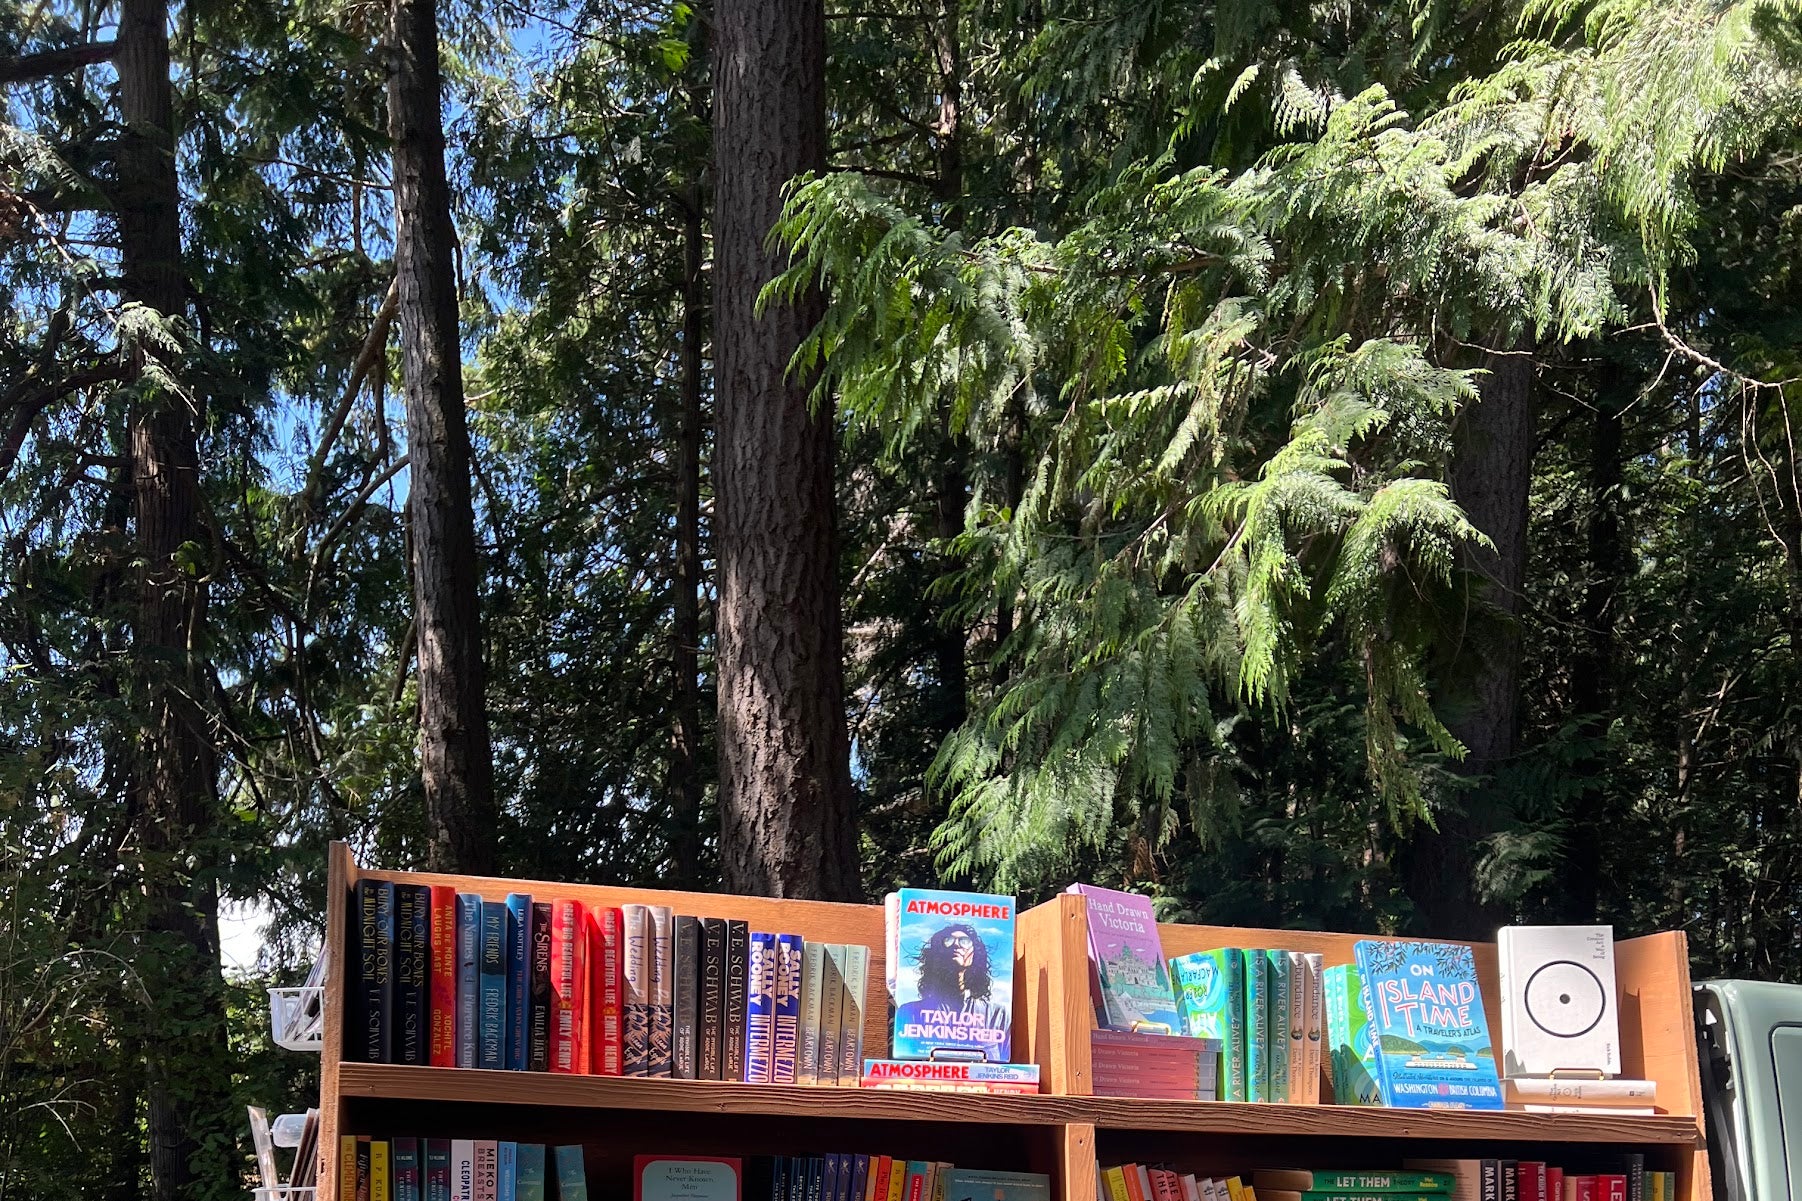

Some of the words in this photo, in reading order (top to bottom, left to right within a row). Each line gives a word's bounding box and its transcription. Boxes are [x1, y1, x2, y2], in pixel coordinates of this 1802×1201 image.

[464, 901, 477, 922] The
[486, 916, 499, 929] MY
[906, 899, 1011, 921] ATMOSPHERE
[1088, 897, 1115, 916] Hand
[1117, 903, 1150, 920] Drawn
[1099, 912, 1146, 934] Victoria
[733, 923, 744, 935] V.
[463, 924, 477, 964] Names
[486, 932, 499, 965] FRIENDS
[732, 938, 744, 951] E.
[751, 942, 763, 1007] ROONEY
[1277, 956, 1286, 967] IS
[1410, 964, 1435, 977] ON
[730, 954, 743, 1023] SCHWAB
[1277, 972, 1286, 982] A
[485, 988, 499, 1021] FREDRIK
[1277, 984, 1286, 1012] RIVER
[1377, 978, 1475, 1029] ISLAND
[432, 1009, 441, 1055] GONZALEZ
[559, 1009, 572, 1038] EMILY
[604, 1015, 617, 1041] EMILY
[920, 1008, 986, 1028] TAYLOR
[1395, 1001, 1473, 1037] TIME
[1423, 1026, 1463, 1038] TRAVELER'S
[1464, 1026, 1481, 1038] ATLAS
[485, 1023, 499, 1062] BACKMAN
[898, 1023, 968, 1041] JENKINS
[969, 1028, 1006, 1044] REID
[1276, 1015, 1286, 1051] ALIVE?
[558, 1040, 571, 1070] HENRY
[604, 1045, 617, 1073] HENRY
[748, 1015, 771, 1084] INTERMEZZO
[773, 1016, 796, 1084] INTERMEZZO
[803, 1027, 817, 1070] BEARTOWN
[823, 1030, 836, 1074] BEARTOWN
[844, 1028, 856, 1072] BEARTOWN
[870, 1063, 970, 1080] ATMOSPHERE
[477, 1148, 485, 1201] BREASTS
[486, 1148, 495, 1188] MIEKO
[1336, 1176, 1356, 1188] LET
[1359, 1176, 1390, 1188] THEM
[1156, 1174, 1169, 1195] THE
[1166, 1174, 1179, 1195] THE
[1484, 1166, 1495, 1201] MARK
[1505, 1167, 1515, 1201] MARK
